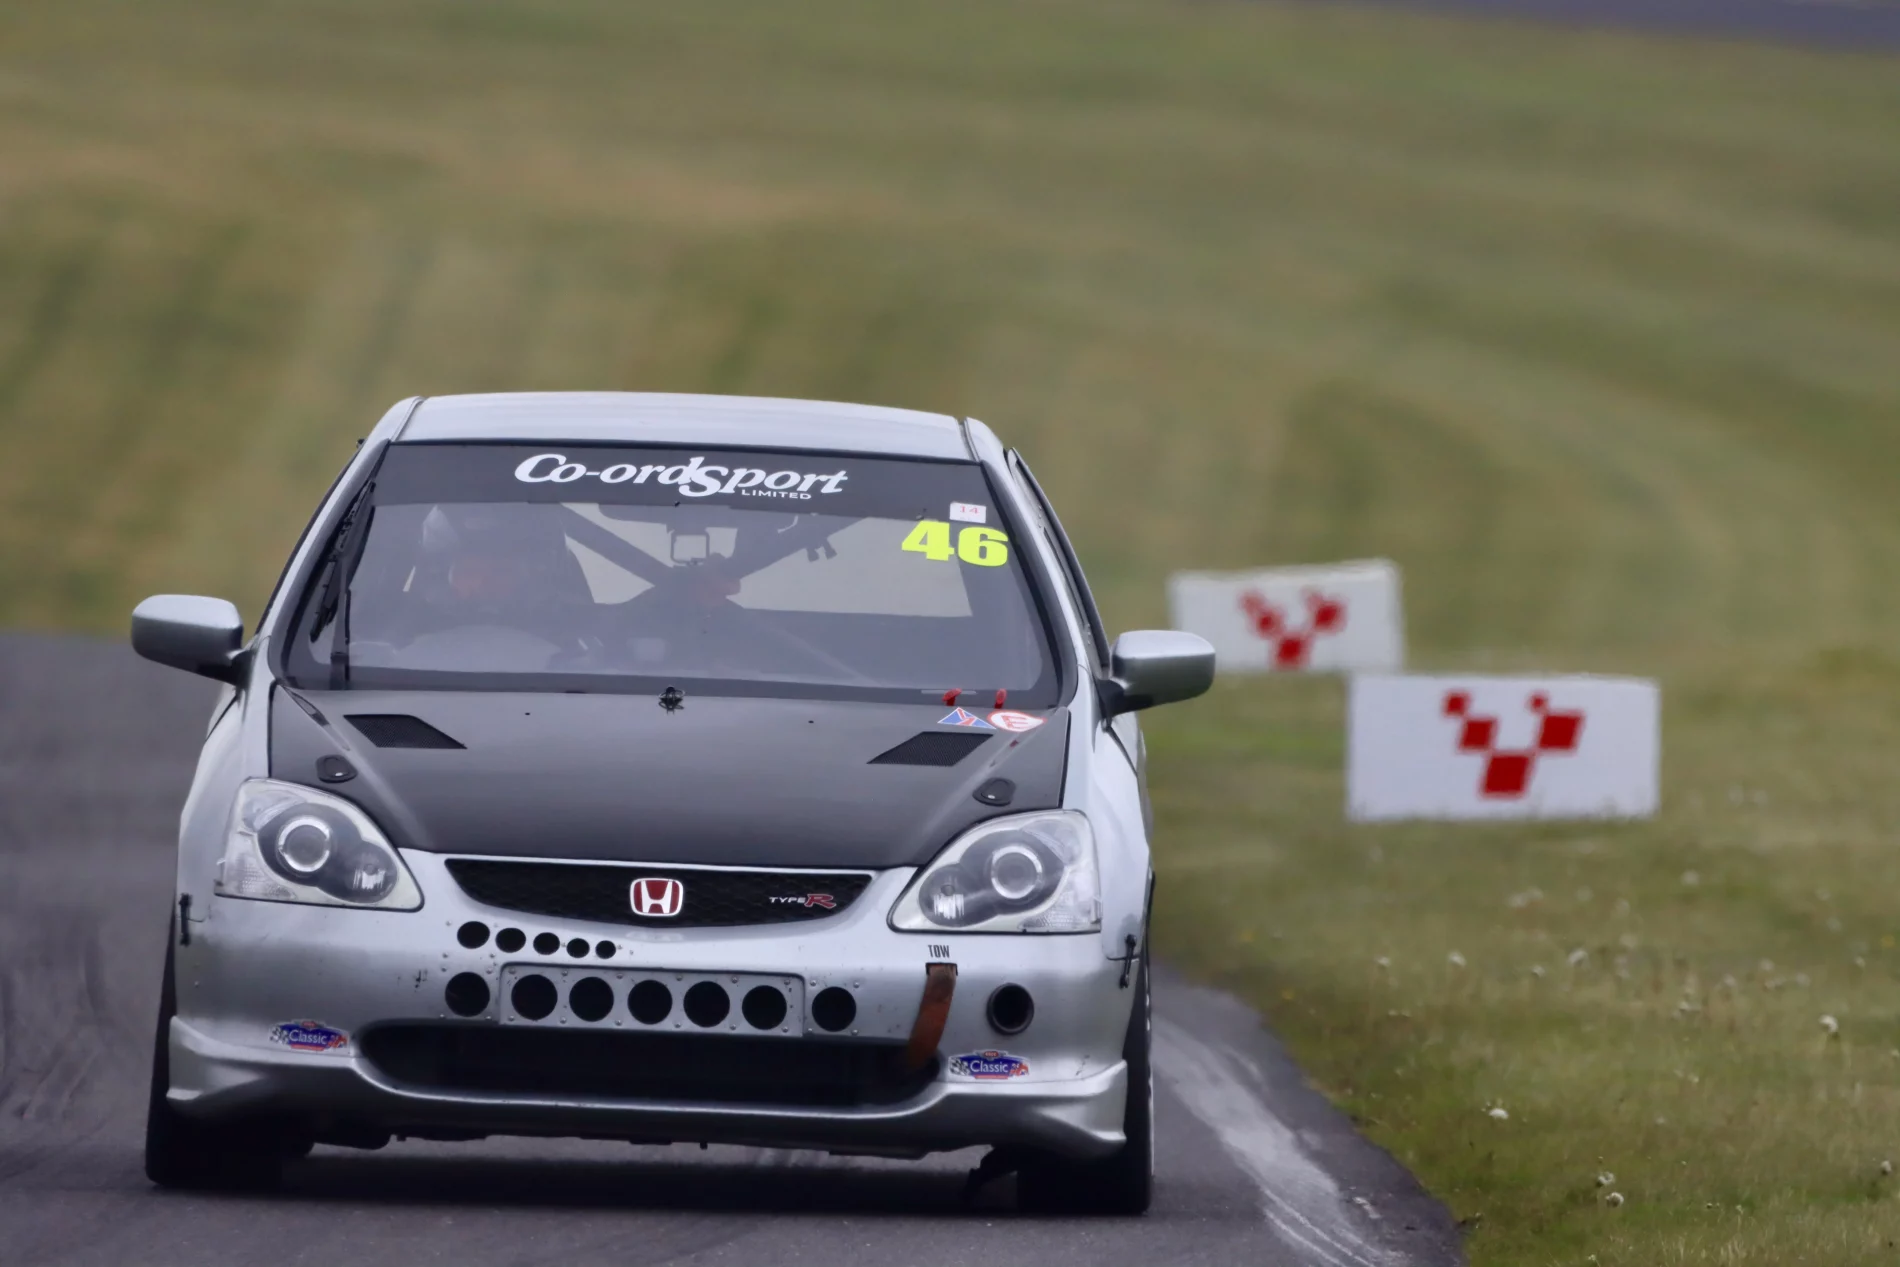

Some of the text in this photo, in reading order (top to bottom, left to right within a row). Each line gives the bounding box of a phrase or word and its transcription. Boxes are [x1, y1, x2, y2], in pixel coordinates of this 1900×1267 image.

[741, 489, 812, 500] LIMITED
[901, 519, 1009, 567] 46
[768, 893, 837, 909] TYPE R
[927, 944, 950, 959] TOW
[288, 1029, 328, 1045] Classic
[969, 1060, 1009, 1073] Classic
